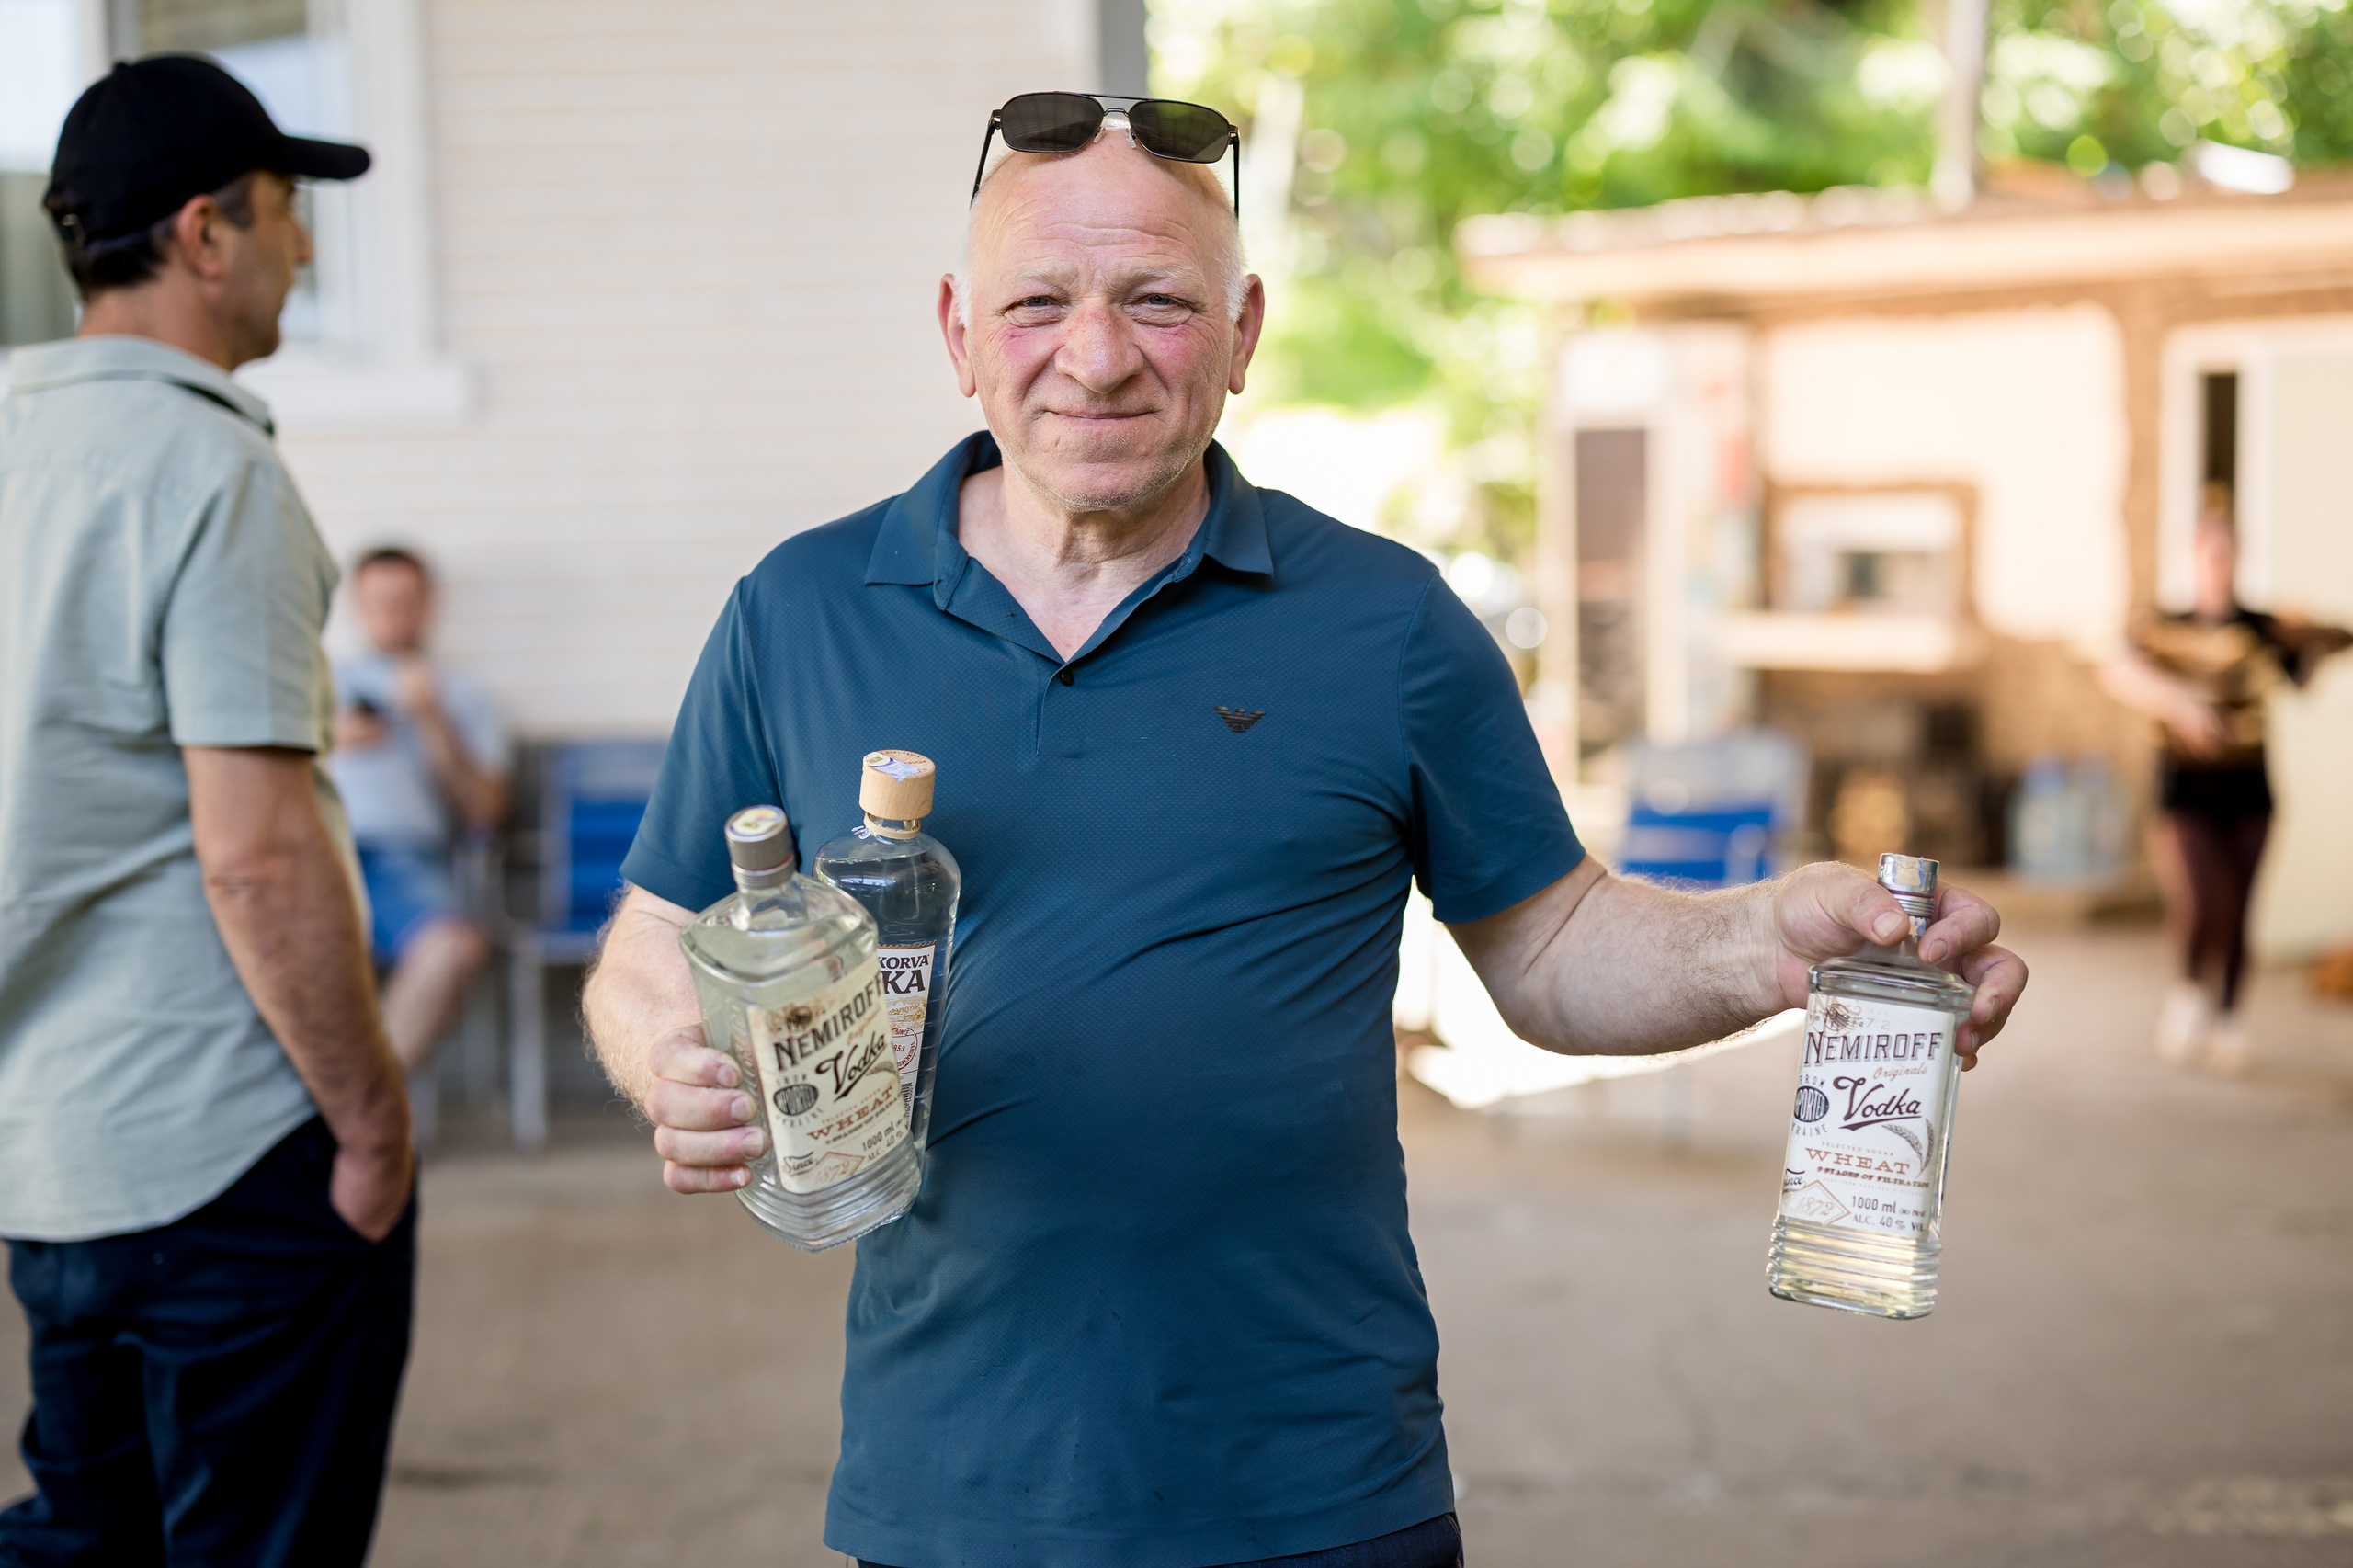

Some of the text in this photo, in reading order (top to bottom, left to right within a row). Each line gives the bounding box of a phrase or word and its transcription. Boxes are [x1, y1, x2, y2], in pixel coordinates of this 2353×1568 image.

[815, 1030, 884, 1094] Vodka
[1803, 1031, 1943, 1066] NEMIROFF
[806, 1085, 892, 1140] WHEAT
[1833, 1076, 1922, 1123] Vodka
[862, 1131, 883, 1153] 1000
[1805, 1147, 1911, 1176] WHEAT
[1851, 1195, 1879, 1211] 1000
[1881, 1200, 1897, 1214] ml
[1879, 1215, 1893, 1228] 40
